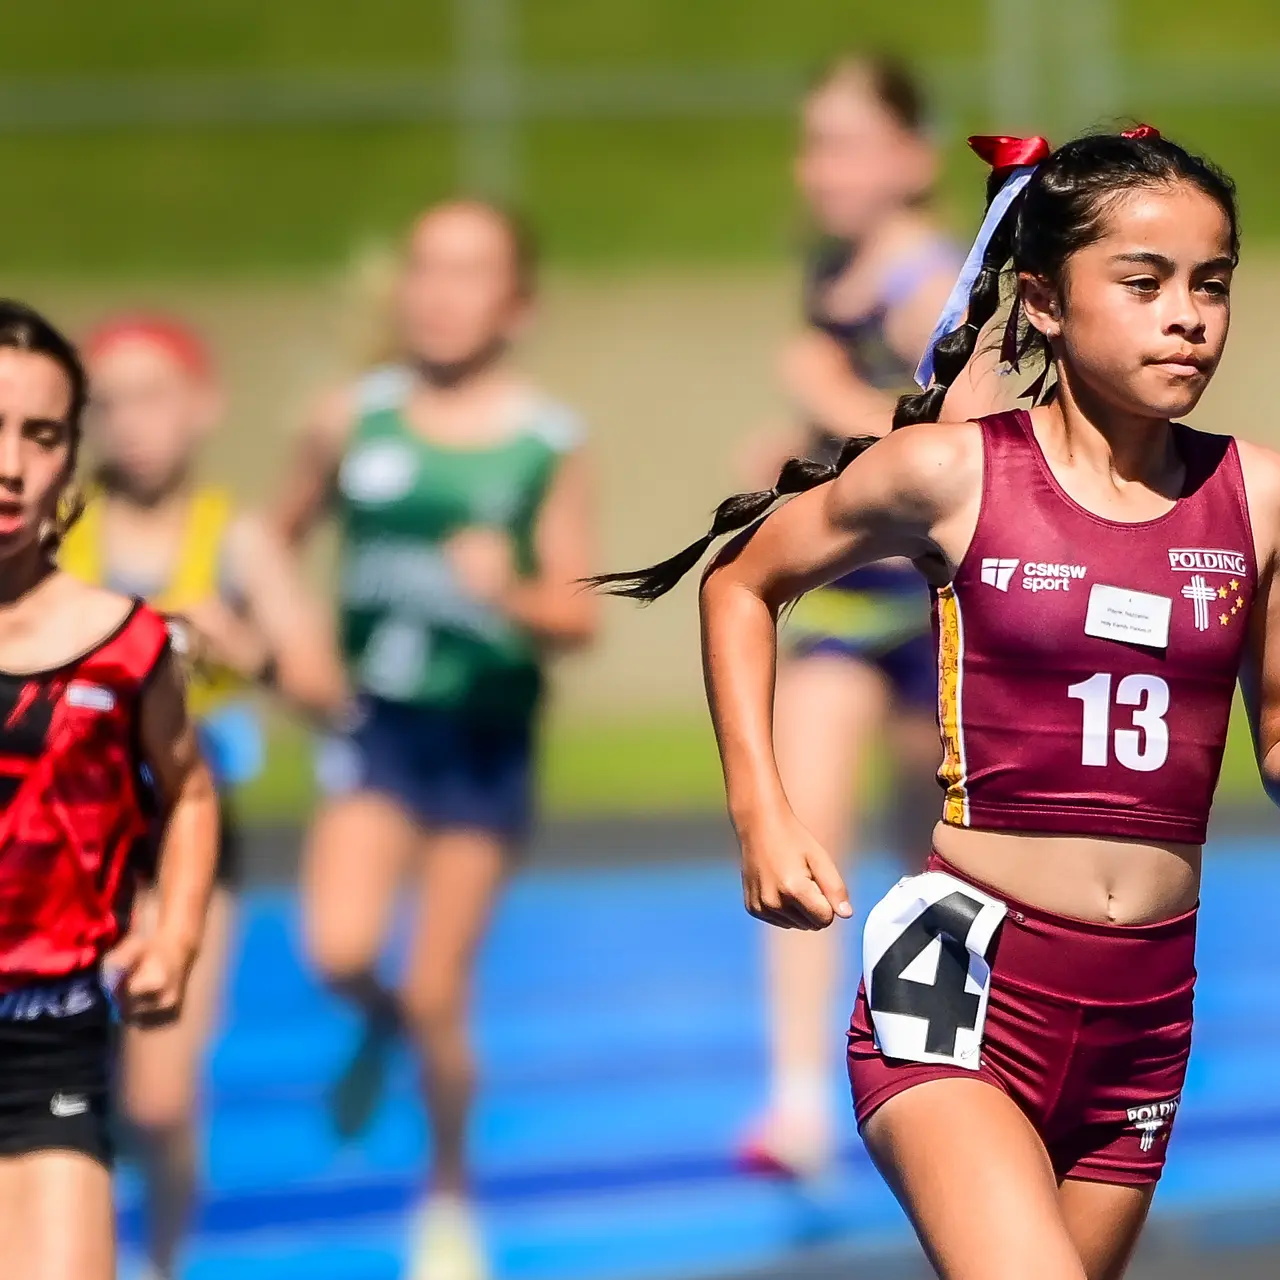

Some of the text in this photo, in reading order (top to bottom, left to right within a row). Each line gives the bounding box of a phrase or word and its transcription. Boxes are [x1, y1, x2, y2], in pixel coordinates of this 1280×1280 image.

[1023, 562, 1087, 580] CSNSW
[1168, 552, 1247, 573] POLDING
[1022, 577, 1070, 593] sport
[1068, 673, 1170, 772] 13
[870, 891, 985, 1058] 4
